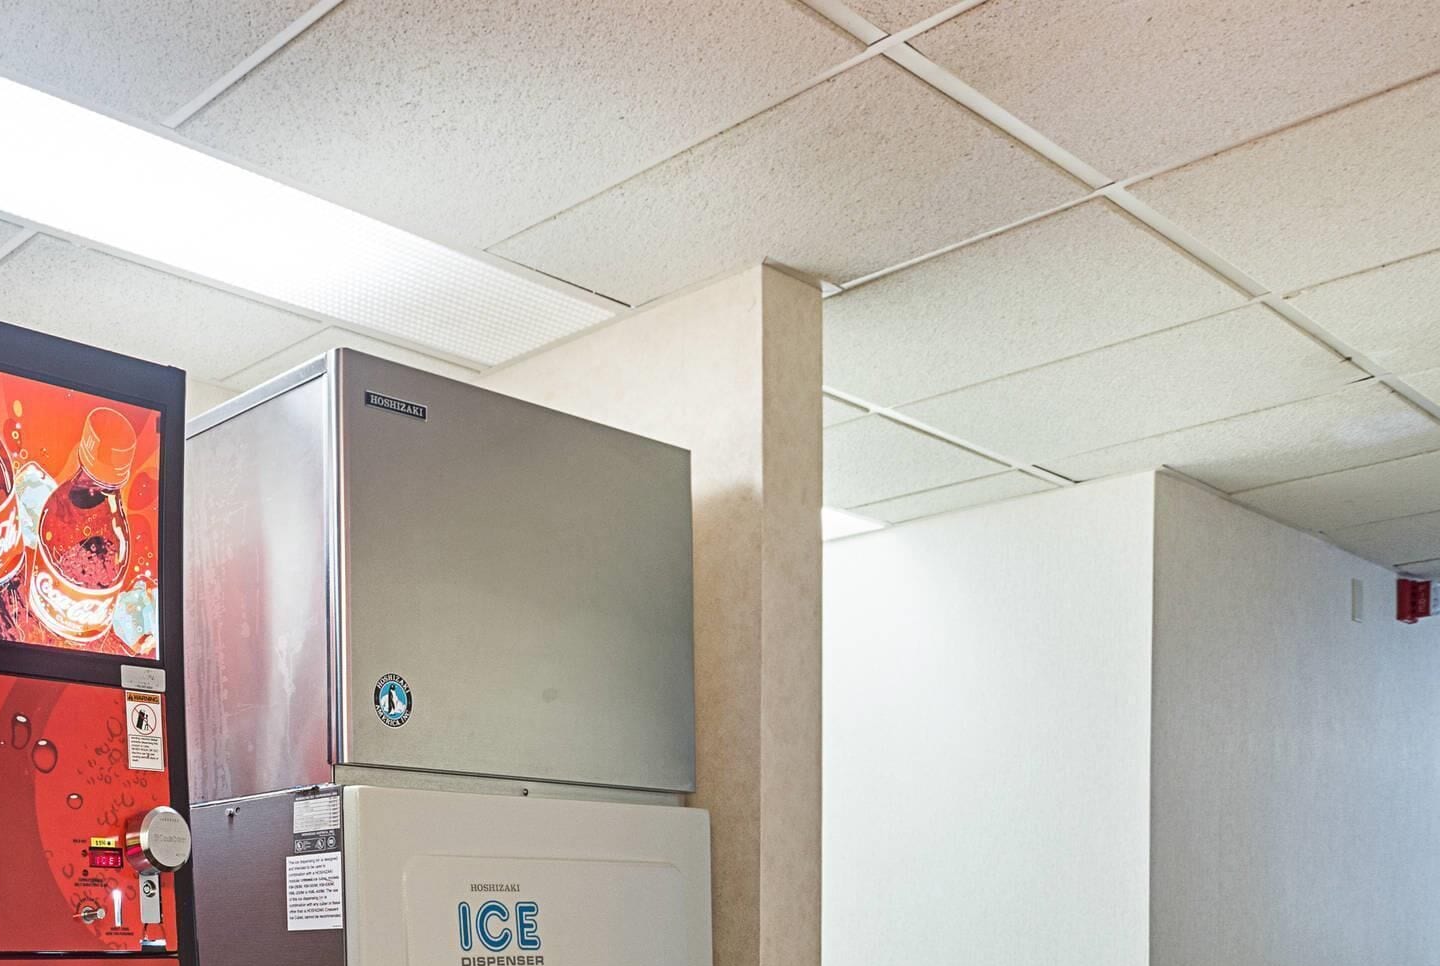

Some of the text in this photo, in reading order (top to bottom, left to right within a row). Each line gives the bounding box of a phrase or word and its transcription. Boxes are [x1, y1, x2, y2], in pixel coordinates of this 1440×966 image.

[370, 395, 424, 417] HOSHIZAKI
[376, 674, 410, 693] HOSHIZAKI
[470, 883, 520, 892] HOSHIZAKI
[458, 900, 542, 952] ICE
[461, 956, 545, 966] DISPENSER
